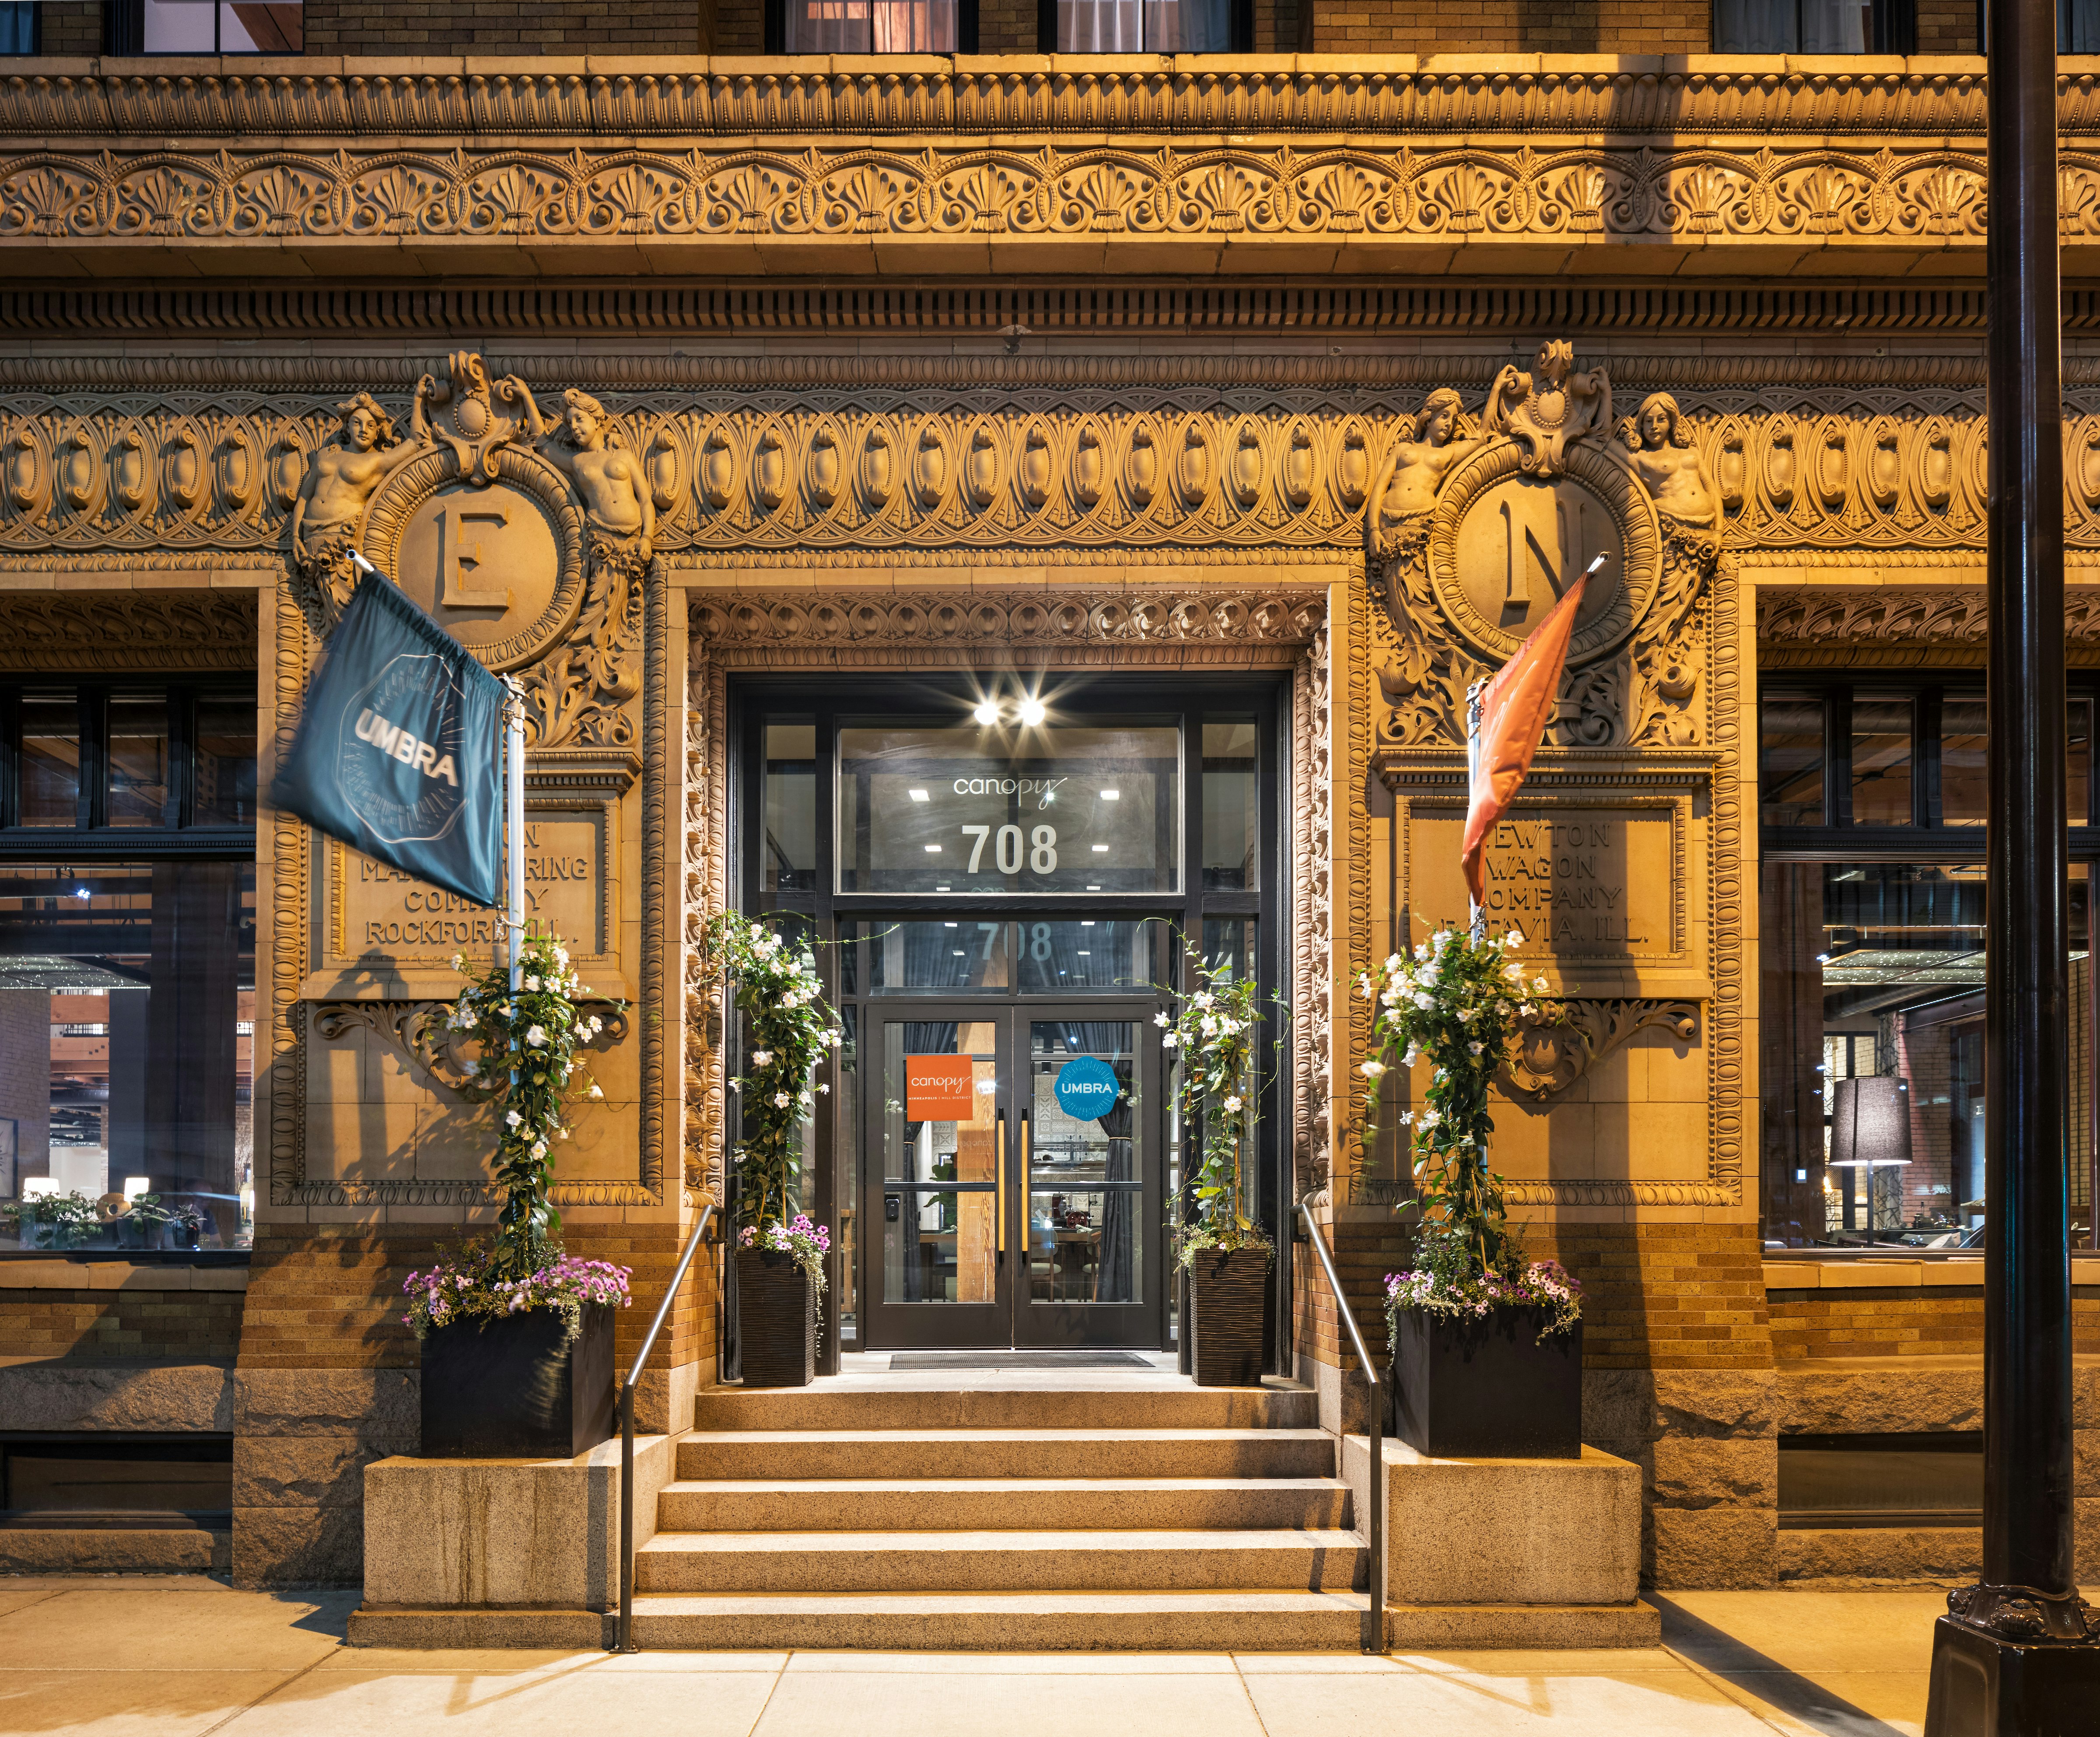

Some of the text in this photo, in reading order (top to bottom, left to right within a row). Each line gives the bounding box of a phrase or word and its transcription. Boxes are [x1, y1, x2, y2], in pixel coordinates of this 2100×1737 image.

[441, 502, 510, 608] E
[1500, 497, 1585, 606] N
[355, 707, 459, 787] UMBRA
[962, 824, 1057, 874] 708
[1486, 824, 1610, 849] EWTON
[1485, 856, 1596, 880] WAGON
[405, 888, 548, 913] COMY
[1468, 887, 1622, 911] OMPANY
[1595, 918, 1649, 943] ILL.
[911, 1076, 971, 1094] canopy
[1062, 1083, 1113, 1093] UMBRA
